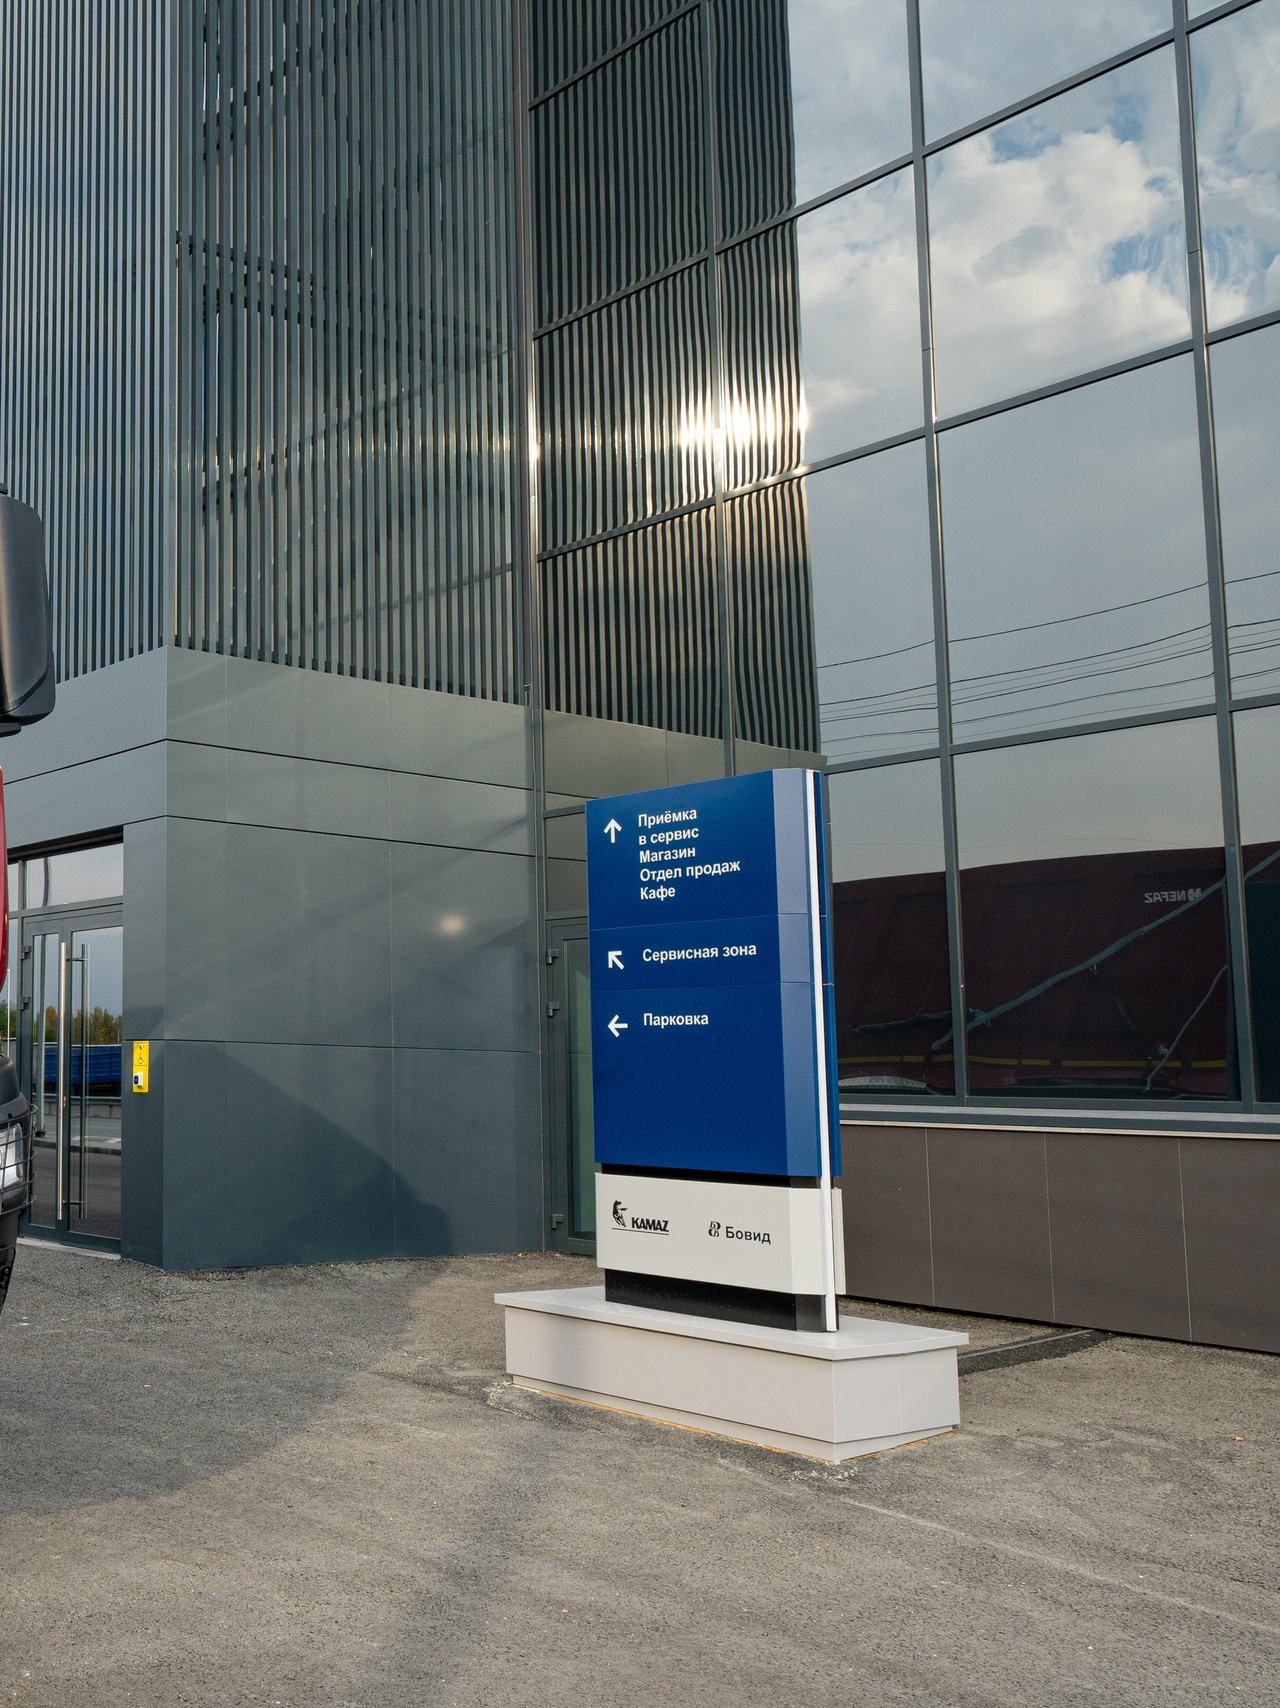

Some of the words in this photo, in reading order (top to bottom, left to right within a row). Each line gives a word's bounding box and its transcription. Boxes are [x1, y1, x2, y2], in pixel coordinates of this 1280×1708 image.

[638, 808, 698, 829] Приёмка
[638, 833, 648, 846] в
[650, 827, 700, 844] сервис
[639, 847, 696, 864] Магазин
[639, 867, 682, 882] Отдел
[685, 860, 741, 879] продаж
[640, 886, 676, 901] Кафе
[642, 944, 719, 964] Сервисная
[722, 944, 757, 958] зона
[643, 1012, 709, 1029] Парковка
[631, 1217, 669, 1232] KAMAZ
[725, 1225, 772, 1245] Бовид
